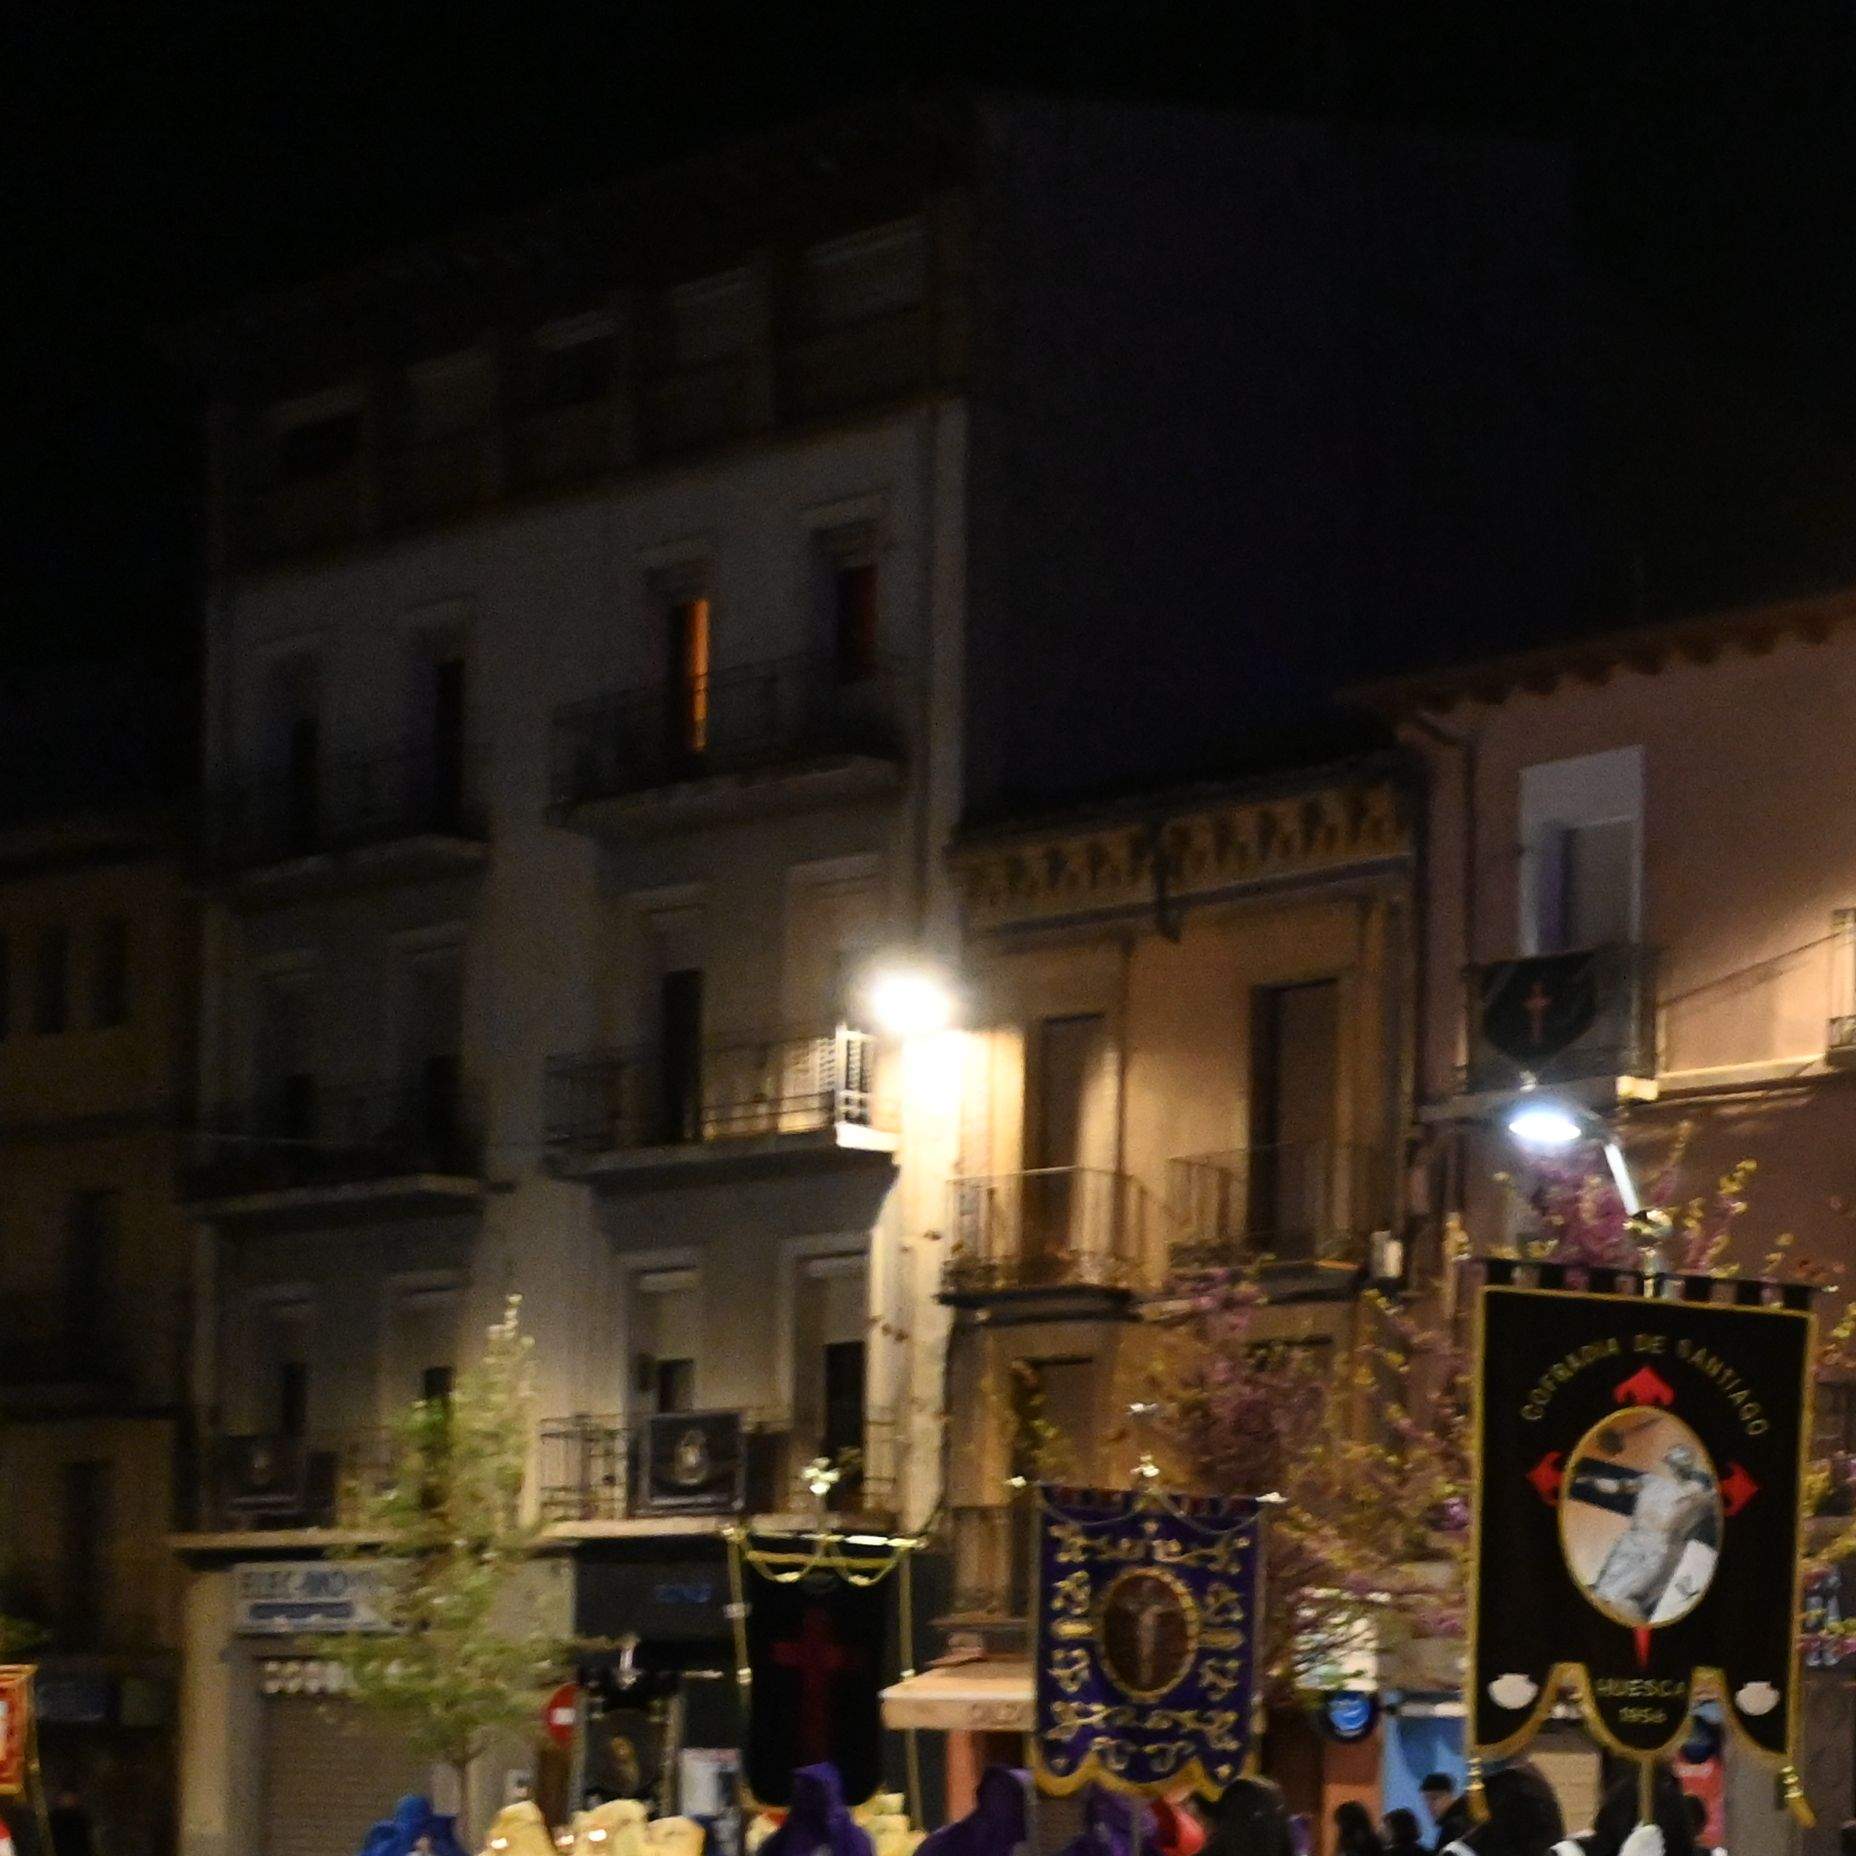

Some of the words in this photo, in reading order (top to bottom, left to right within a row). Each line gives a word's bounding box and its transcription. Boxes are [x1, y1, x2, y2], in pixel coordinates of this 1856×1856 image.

[1632, 1333, 1668, 1354] DE
[1677, 1338, 1770, 1436] SANTIAGO
[1597, 1678, 1686, 1697] HUESCA
